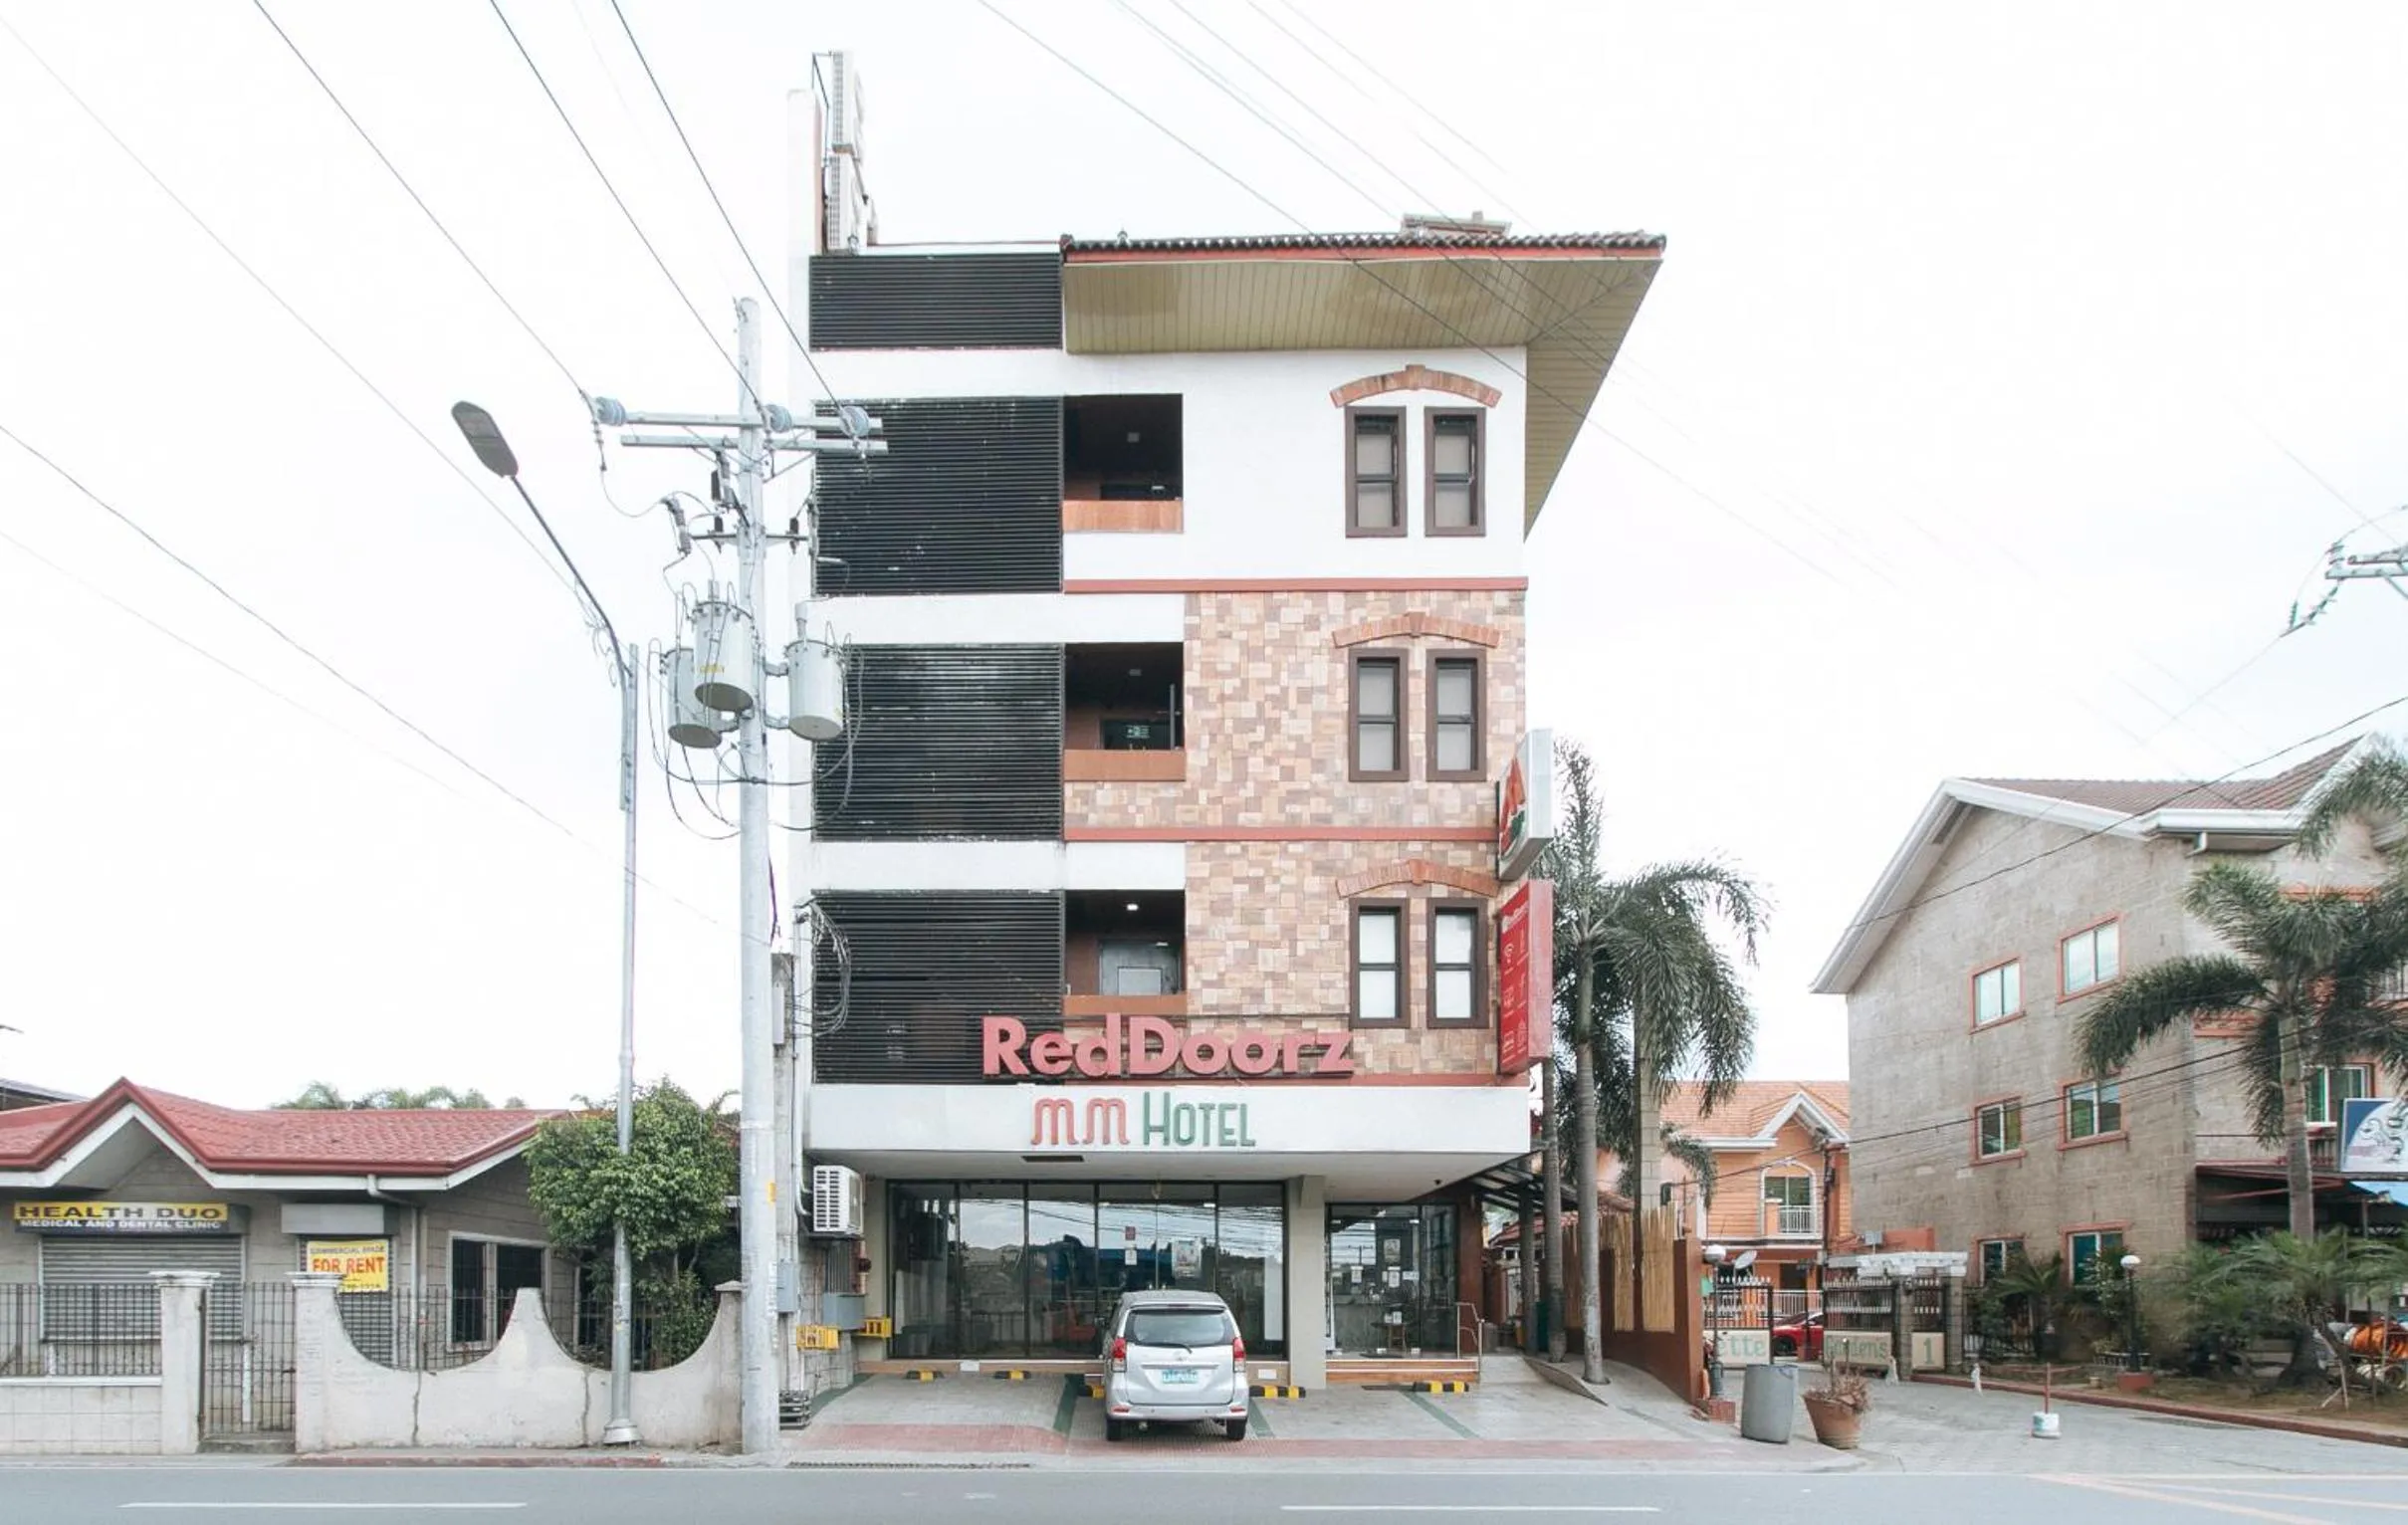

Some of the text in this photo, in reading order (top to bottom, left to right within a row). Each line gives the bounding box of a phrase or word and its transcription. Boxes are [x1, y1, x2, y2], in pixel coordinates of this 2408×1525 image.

[982, 1012, 1355, 1077] RedDoorz
[19, 1205, 222, 1219] HEALTH DUO
[20, 1219, 82, 1228] MEDICAL
[118, 1220, 172, 1229] DENTAL
[175, 1221, 222, 1230] CLINIC
[313, 1256, 385, 1274] FOR RENT
[1922, 1337, 1934, 1364] 1
